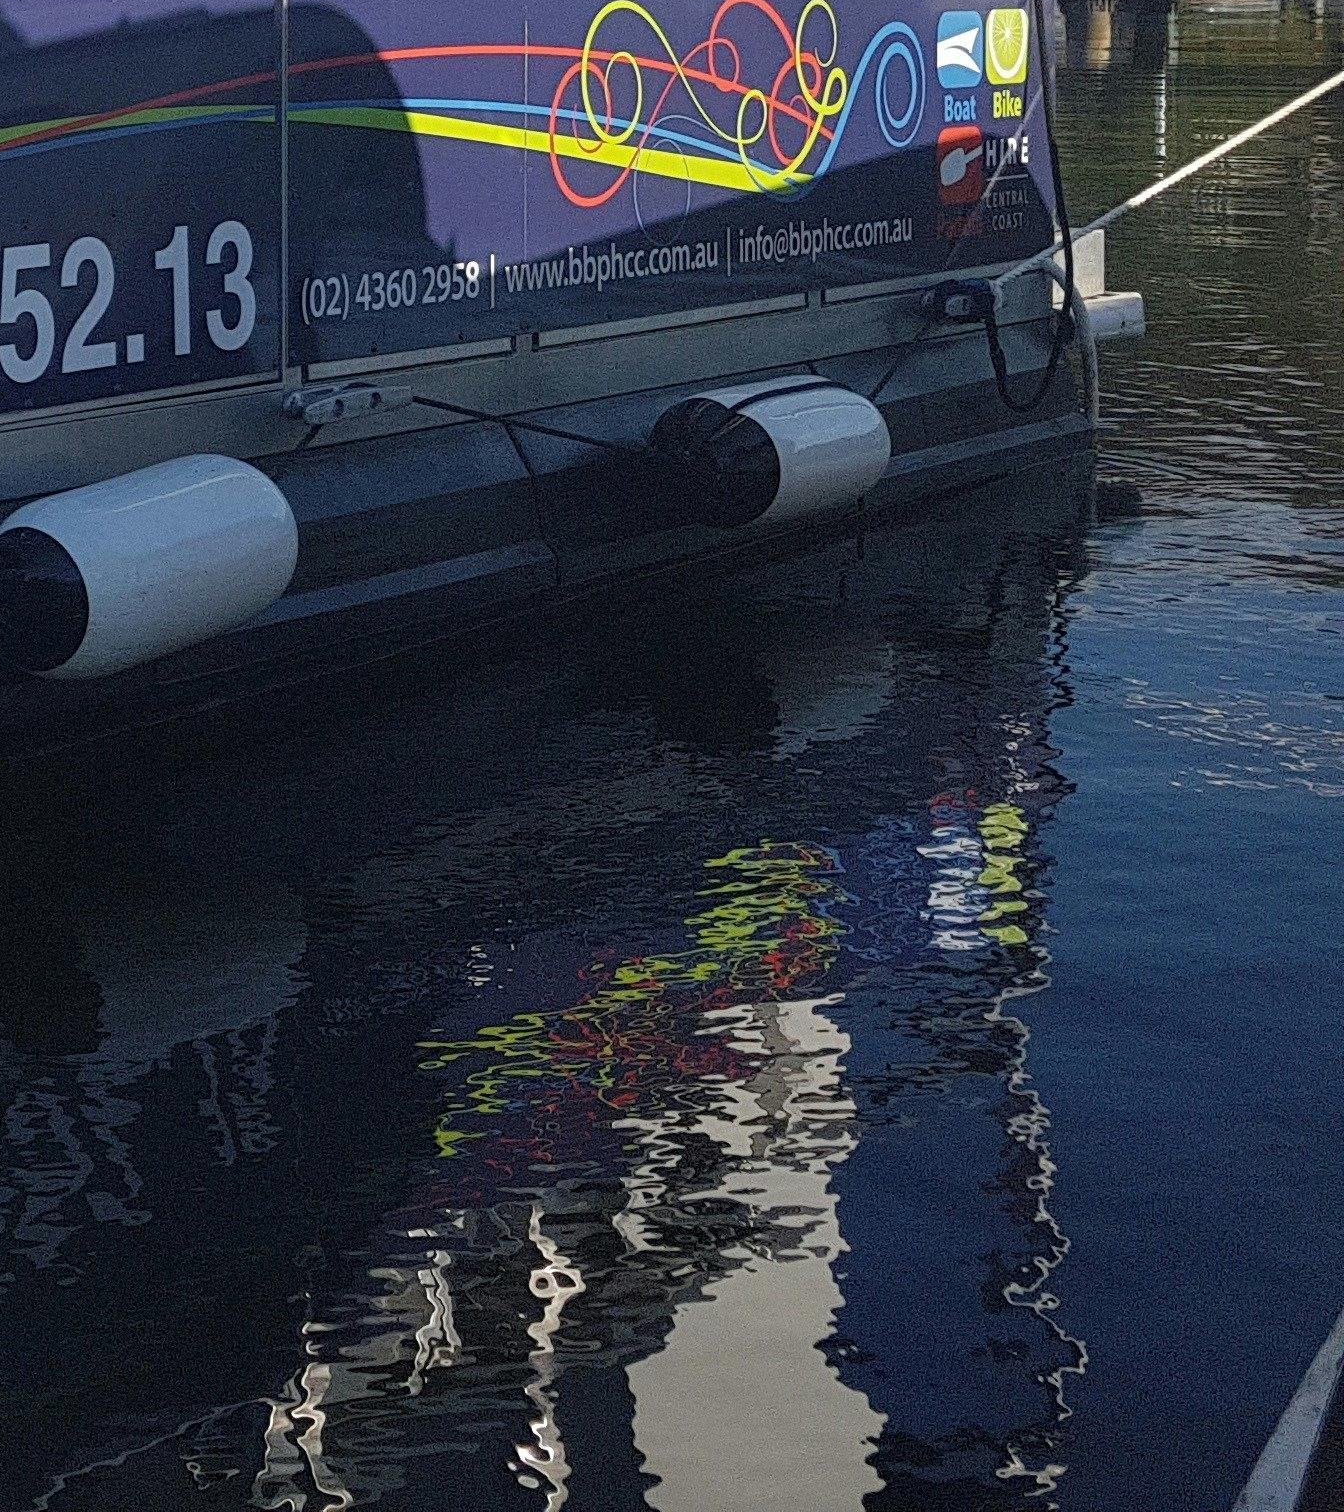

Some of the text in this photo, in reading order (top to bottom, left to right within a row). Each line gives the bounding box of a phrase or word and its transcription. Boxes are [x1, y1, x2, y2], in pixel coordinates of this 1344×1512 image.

[944, 94, 977, 122] Boat
[993, 89, 1022, 118] Bike
[985, 136, 1029, 167] HIRE
[985, 188, 1029, 208] CENTRAL
[992, 211, 1023, 230] COAST
[301, 272, 350, 325] (02)
[355, 268, 417, 311] 4360
[421, 260, 480, 304] 2958
[504, 242, 719, 293] www.bbphcc.com.au
[739, 217, 913, 263] info@bbphcc.com.au
